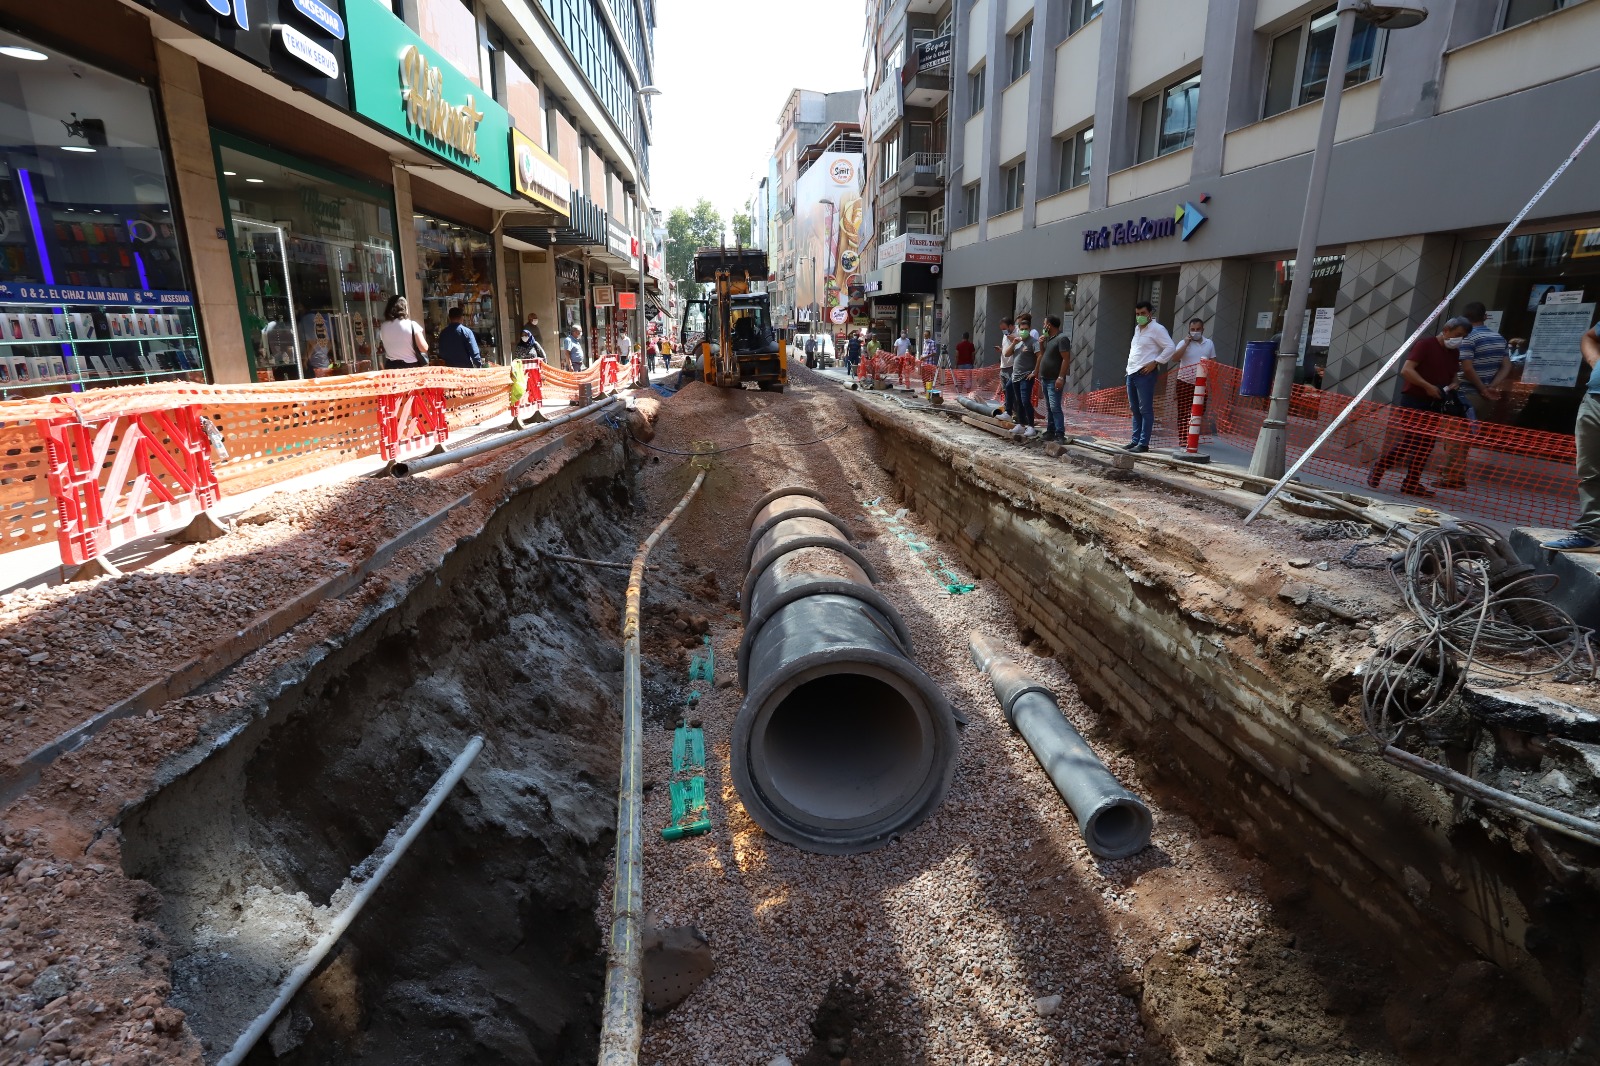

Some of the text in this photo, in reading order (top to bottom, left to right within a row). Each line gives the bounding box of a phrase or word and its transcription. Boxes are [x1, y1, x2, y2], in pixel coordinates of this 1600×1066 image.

[834, 167, 849, 175] Simit
[1082, 217, 1175, 251] Türk Telekom
[29, 288, 37, 298] &
[49, 289, 60, 298] EL
[87, 291, 105, 300] ALIM
[106, 292, 128, 301] SATIM
[160, 294, 190, 303] AKSESUAR
